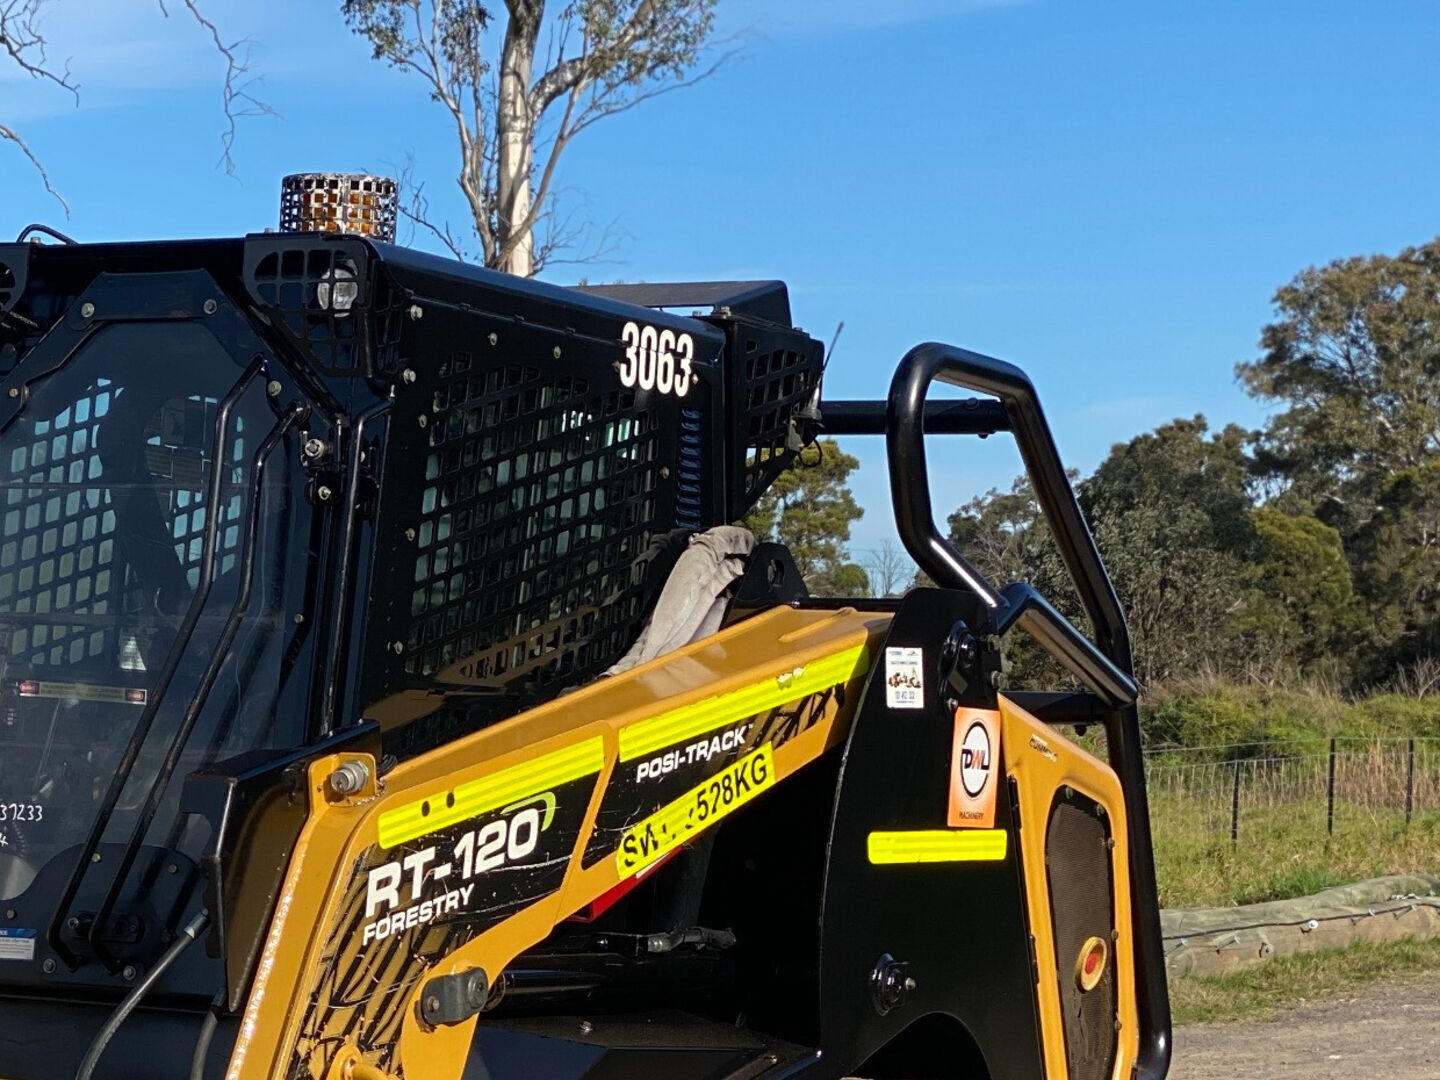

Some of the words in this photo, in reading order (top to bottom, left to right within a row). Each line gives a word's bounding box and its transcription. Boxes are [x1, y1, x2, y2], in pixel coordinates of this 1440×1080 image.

[620, 321, 694, 397] 3063
[636, 726, 748, 783] POSI-TRACK
[365, 808, 539, 918] RT-120
[363, 883, 475, 946] FORESTRY
